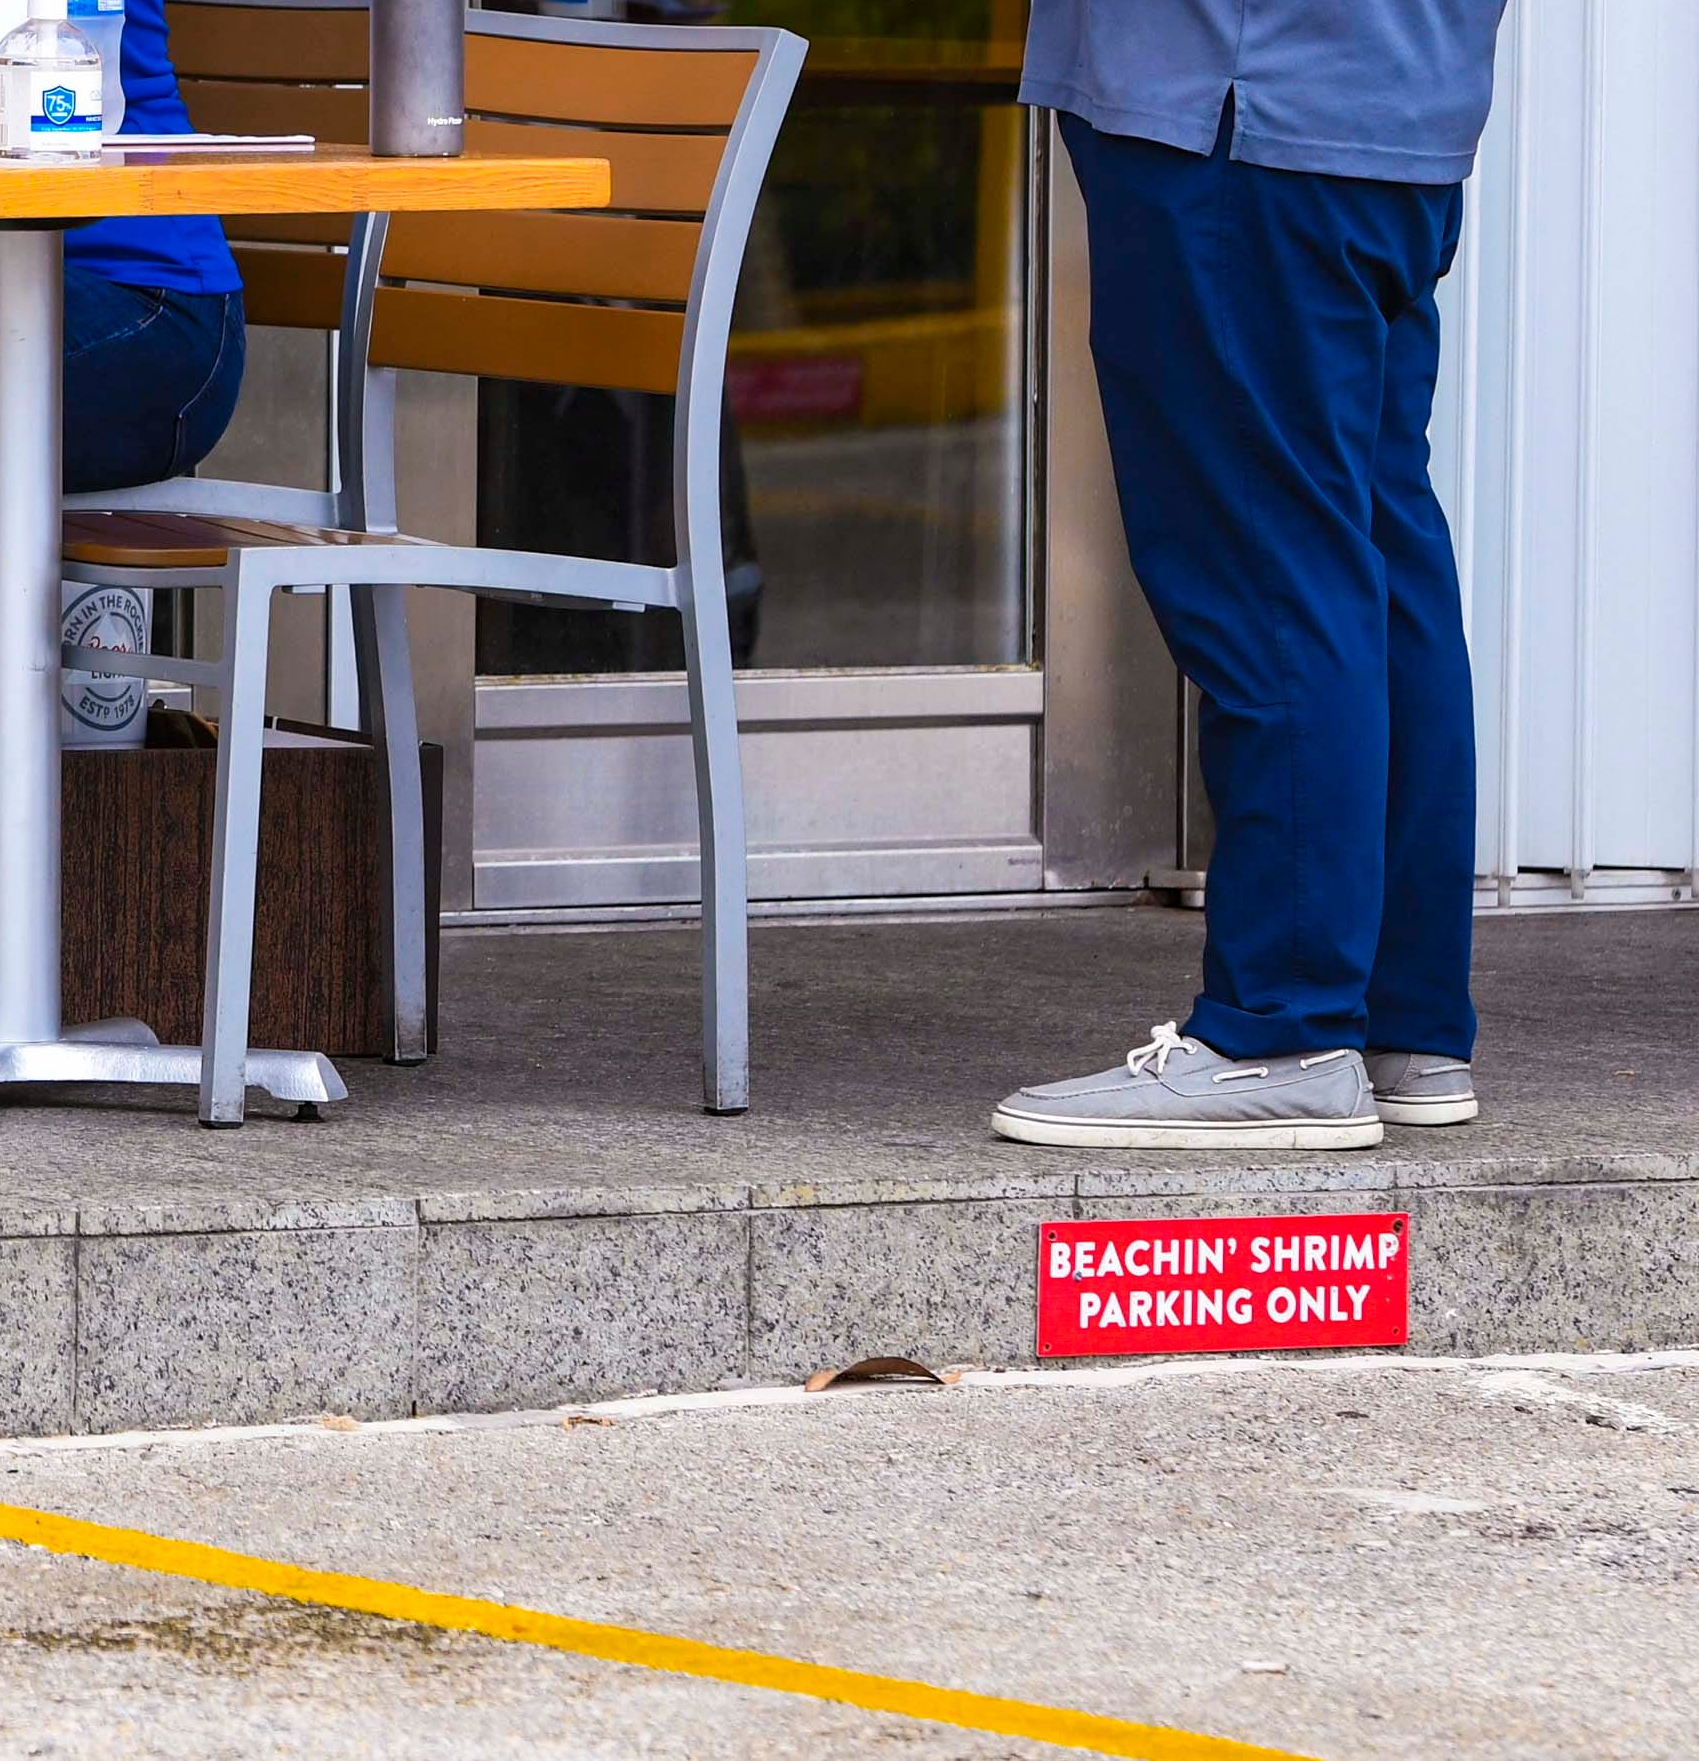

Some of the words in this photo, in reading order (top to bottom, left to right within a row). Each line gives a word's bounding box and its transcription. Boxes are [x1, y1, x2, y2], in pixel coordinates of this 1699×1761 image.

[81, 599, 98, 620] IN
[99, 594, 124, 610] THE
[1049, 1238, 1238, 1280] BEACHIN'
[1251, 1233, 1400, 1275] SHRIMP
[1079, 1288, 1253, 1329] PARKING
[1267, 1285, 1371, 1324] ONLY
